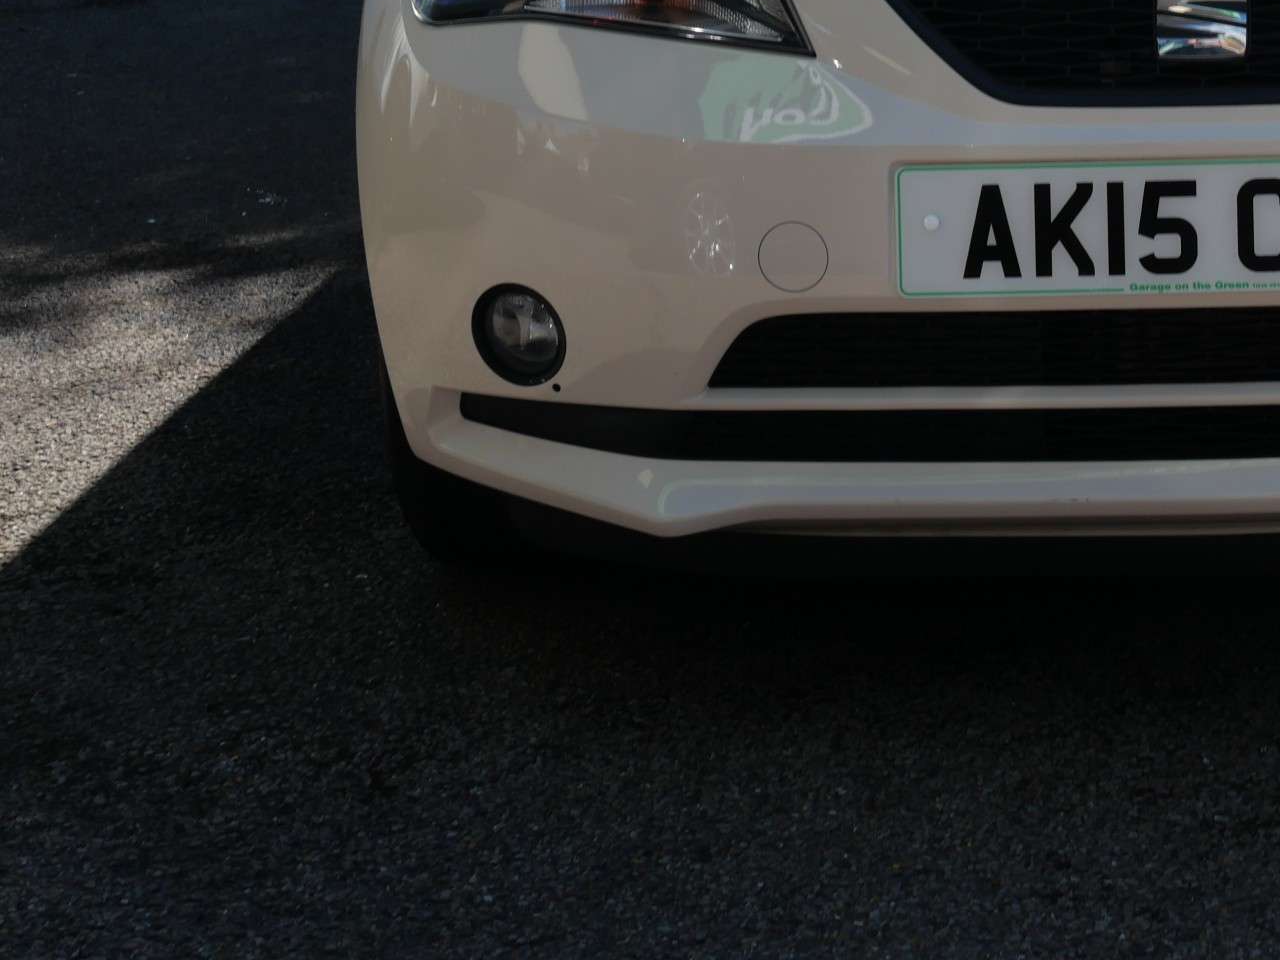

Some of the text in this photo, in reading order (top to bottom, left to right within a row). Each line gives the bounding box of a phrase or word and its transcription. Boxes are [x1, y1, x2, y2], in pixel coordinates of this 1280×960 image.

[963, 180, 1199, 279] AK15
[1130, 282, 1171, 293] Garage
[1193, 281, 1211, 289] the
[1215, 281, 1249, 290] Green
